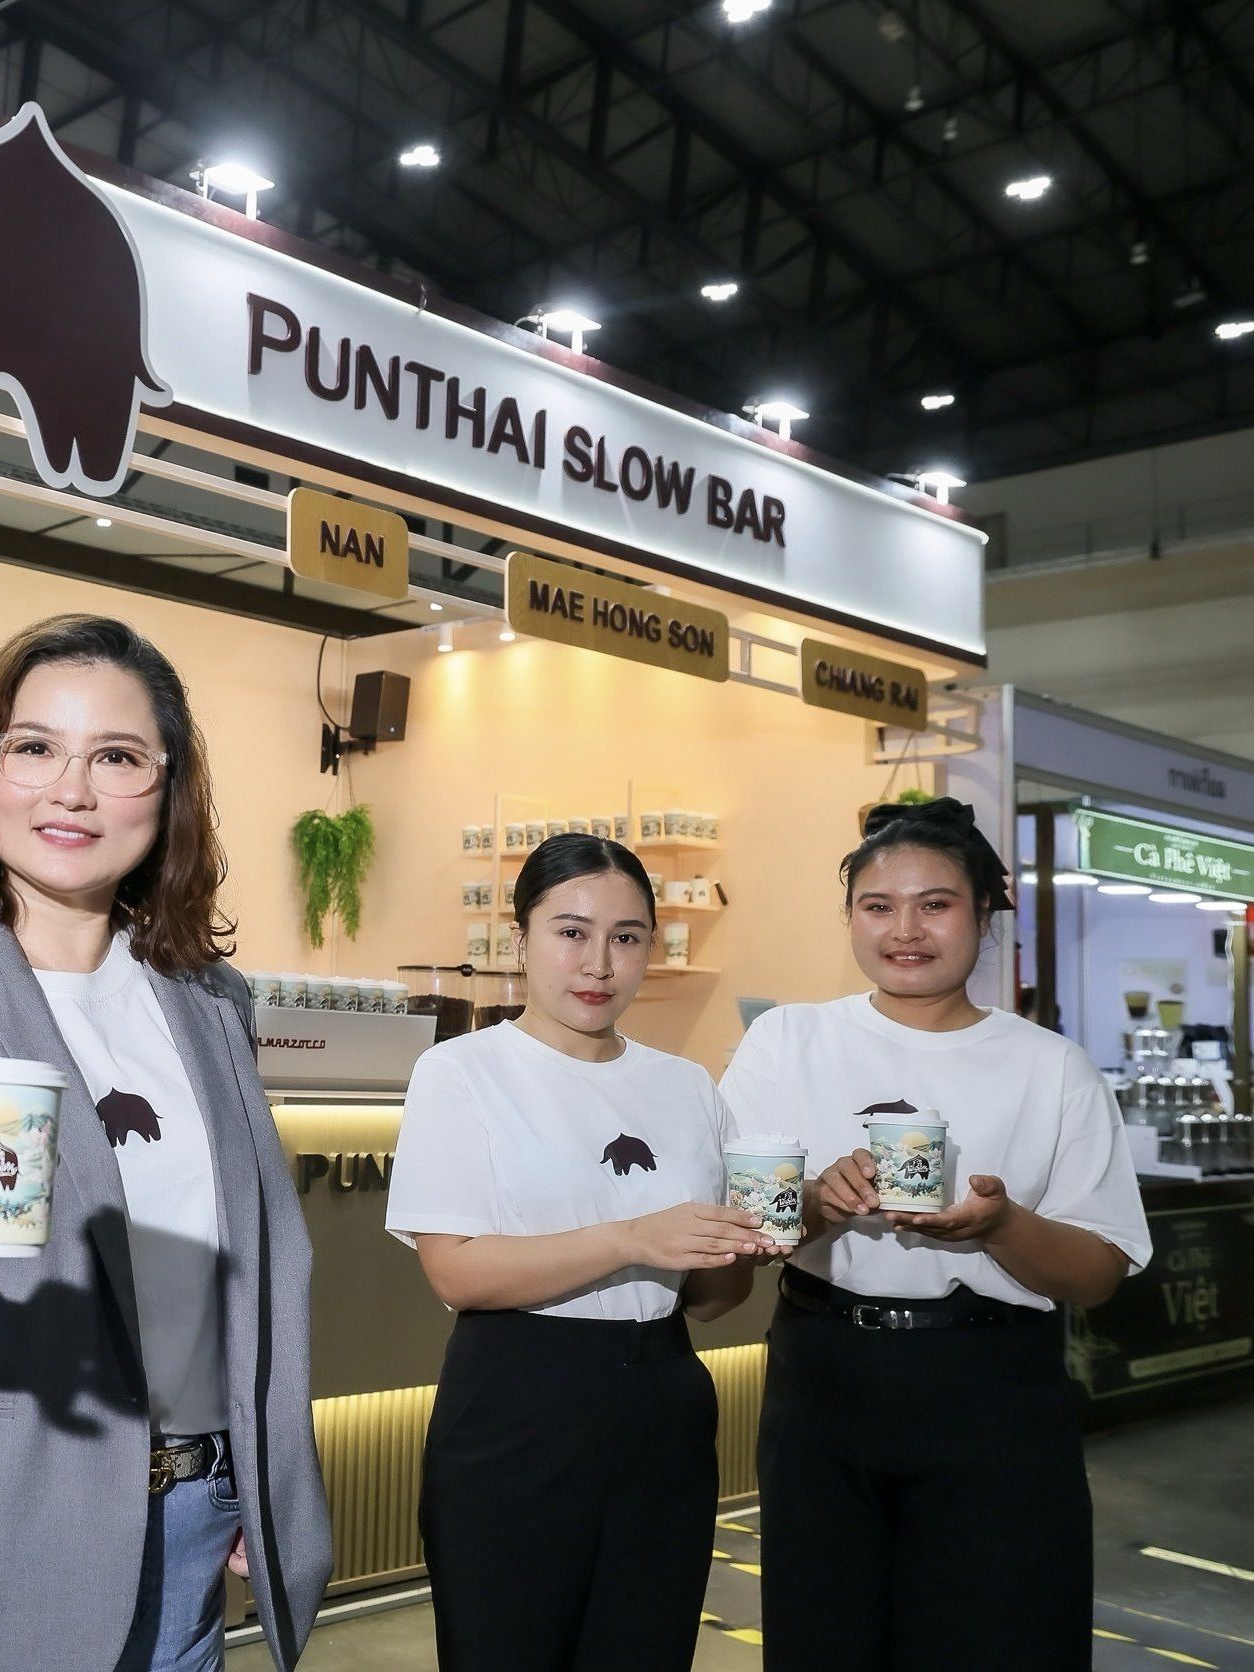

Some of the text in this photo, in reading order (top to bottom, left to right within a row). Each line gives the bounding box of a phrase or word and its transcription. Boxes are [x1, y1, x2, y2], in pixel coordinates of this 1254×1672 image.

[246, 291, 786, 548] PUNTHAI SLOW BAR
[319, 520, 385, 569] NAN
[528, 578, 715, 658] MAE HONG SON
[814, 660, 919, 711] CHIANG RAI
[297, 1152, 394, 1194] PUN
